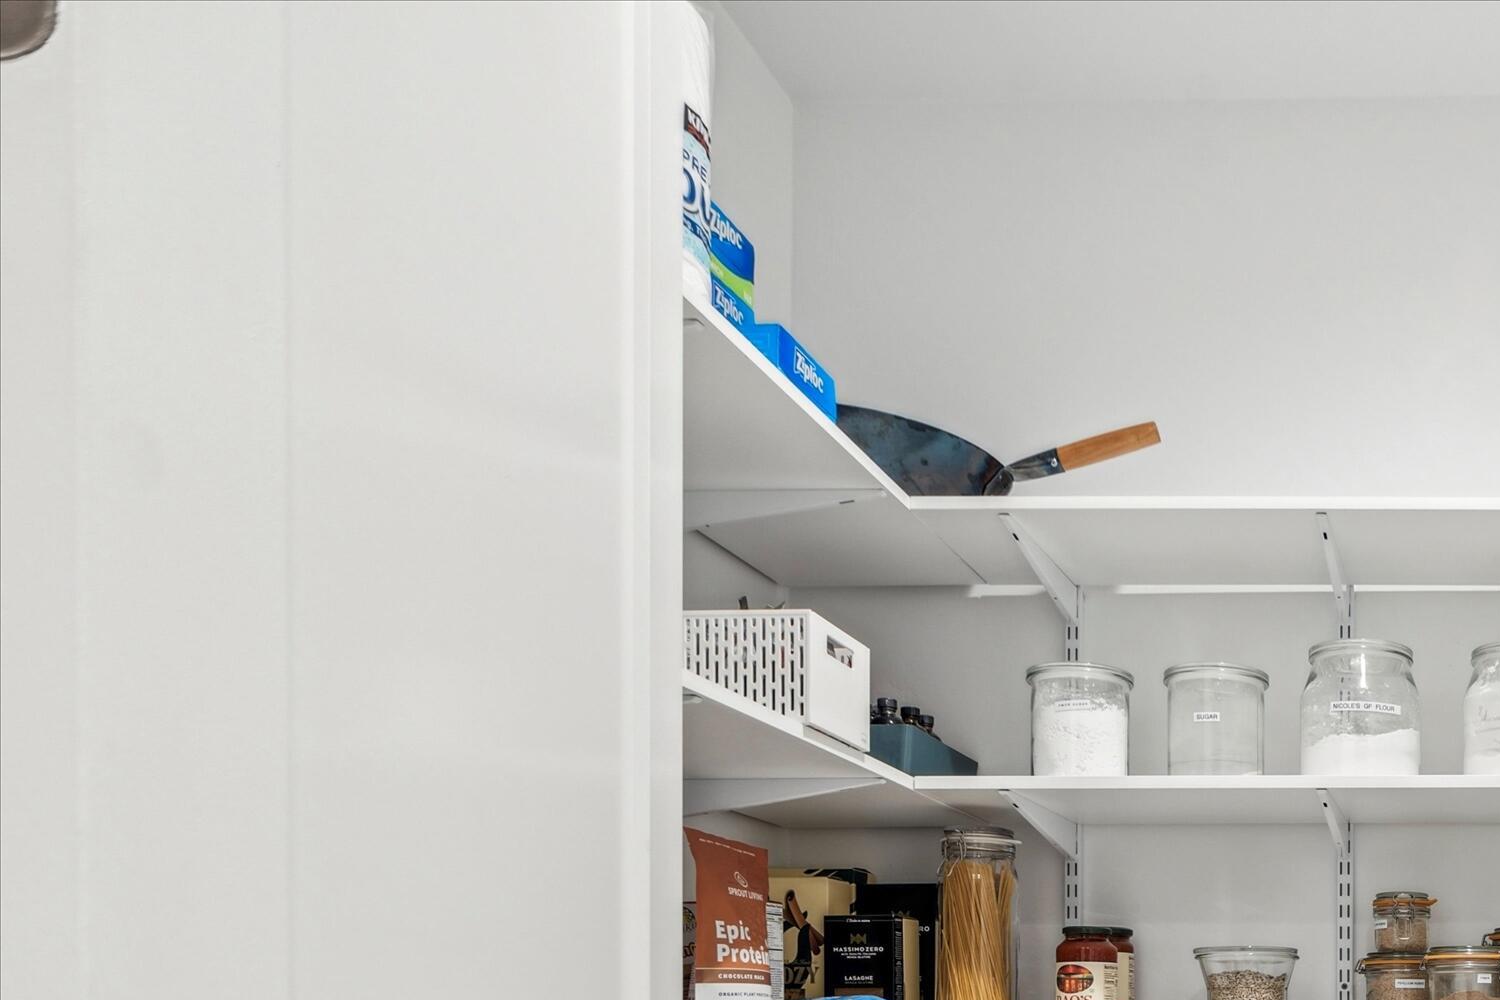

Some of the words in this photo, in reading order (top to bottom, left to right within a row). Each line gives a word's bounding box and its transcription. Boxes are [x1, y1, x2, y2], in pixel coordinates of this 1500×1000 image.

[710, 207, 743, 249] Ziploc
[714, 284, 744, 325] Ziploc
[795, 351, 824, 393] Ziploc
[1376, 704, 1394, 712] FLOUR
[715, 920, 751, 943] Epic
[717, 944, 769, 965] Protein
